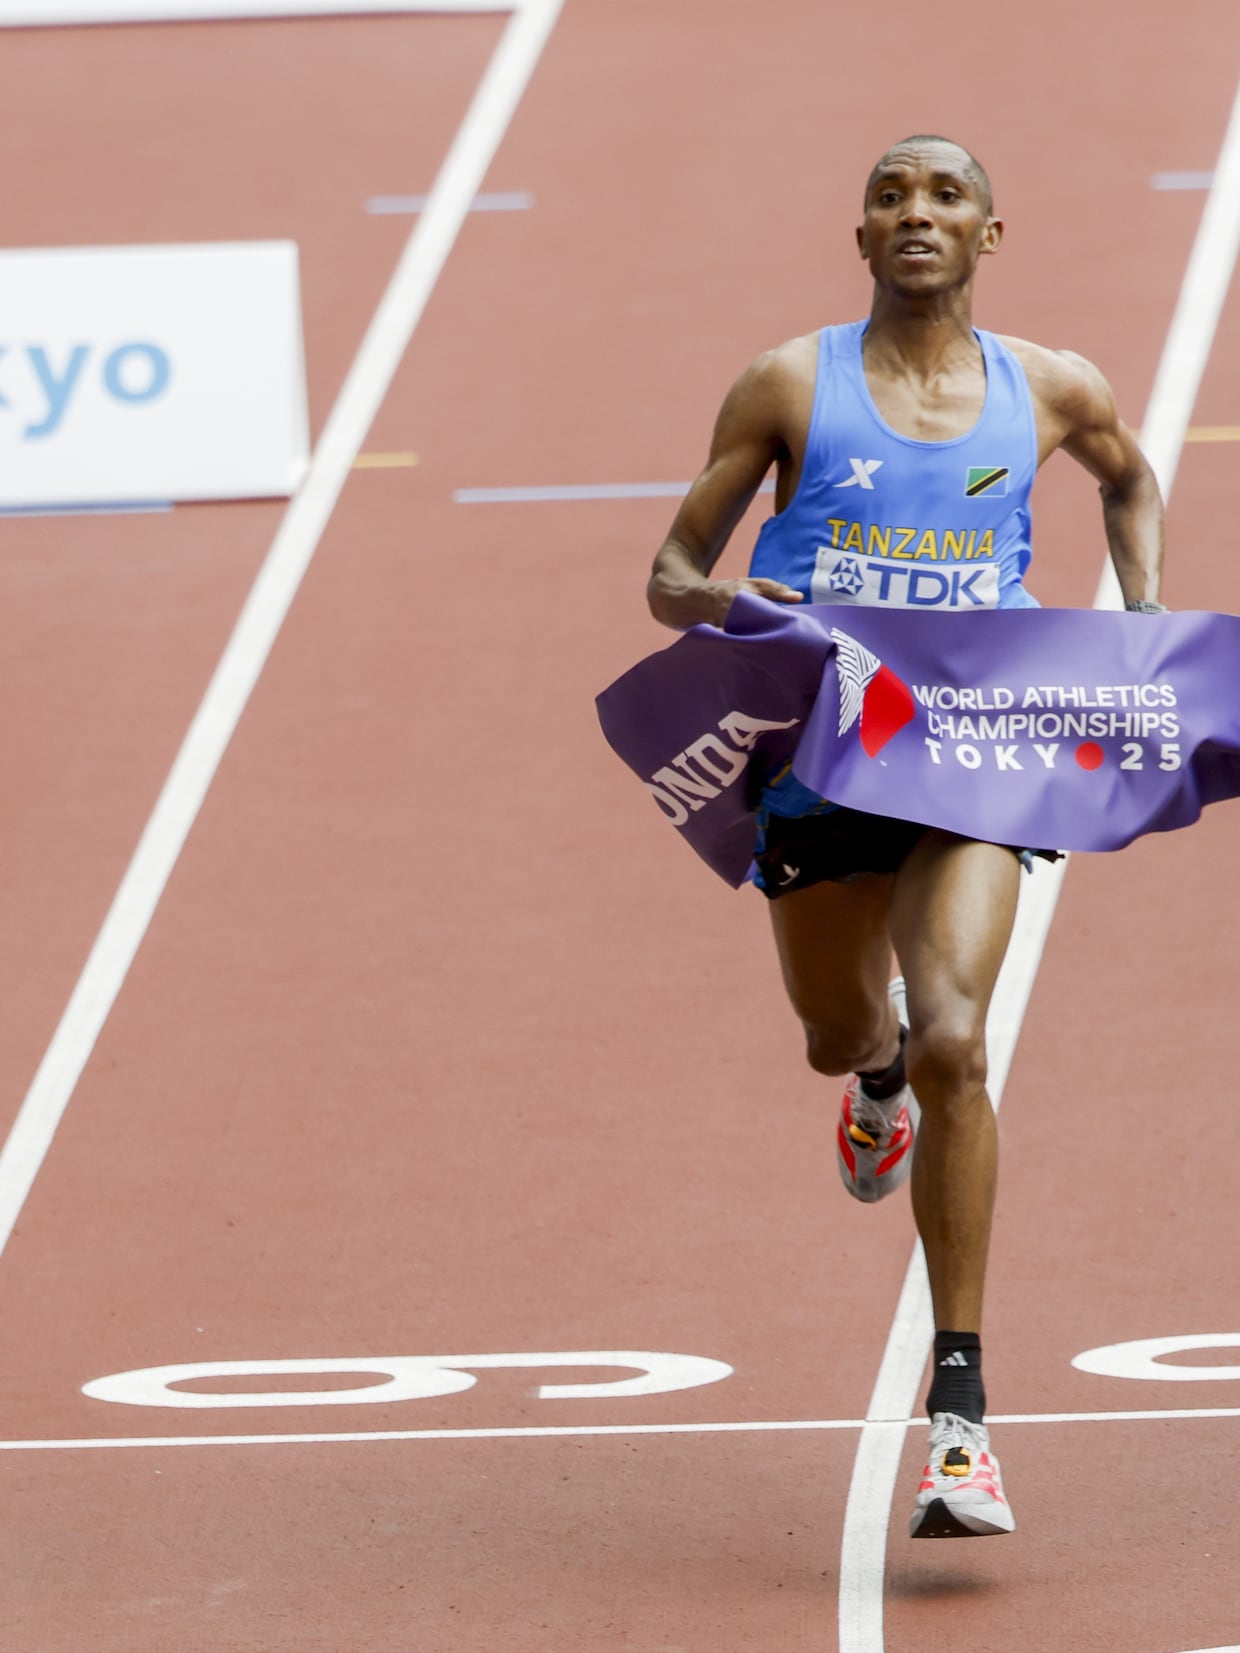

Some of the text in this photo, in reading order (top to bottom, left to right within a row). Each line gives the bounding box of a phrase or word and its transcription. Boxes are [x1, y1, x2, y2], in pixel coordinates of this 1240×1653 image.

[827, 518, 995, 560] TANZANIA
[866, 562, 984, 606] TDK
[912, 684, 1177, 710] WORLD ATHLETICS
[928, 712, 1180, 740] CHAMPIONSHIPS
[81, 1350, 733, 1408] 6
